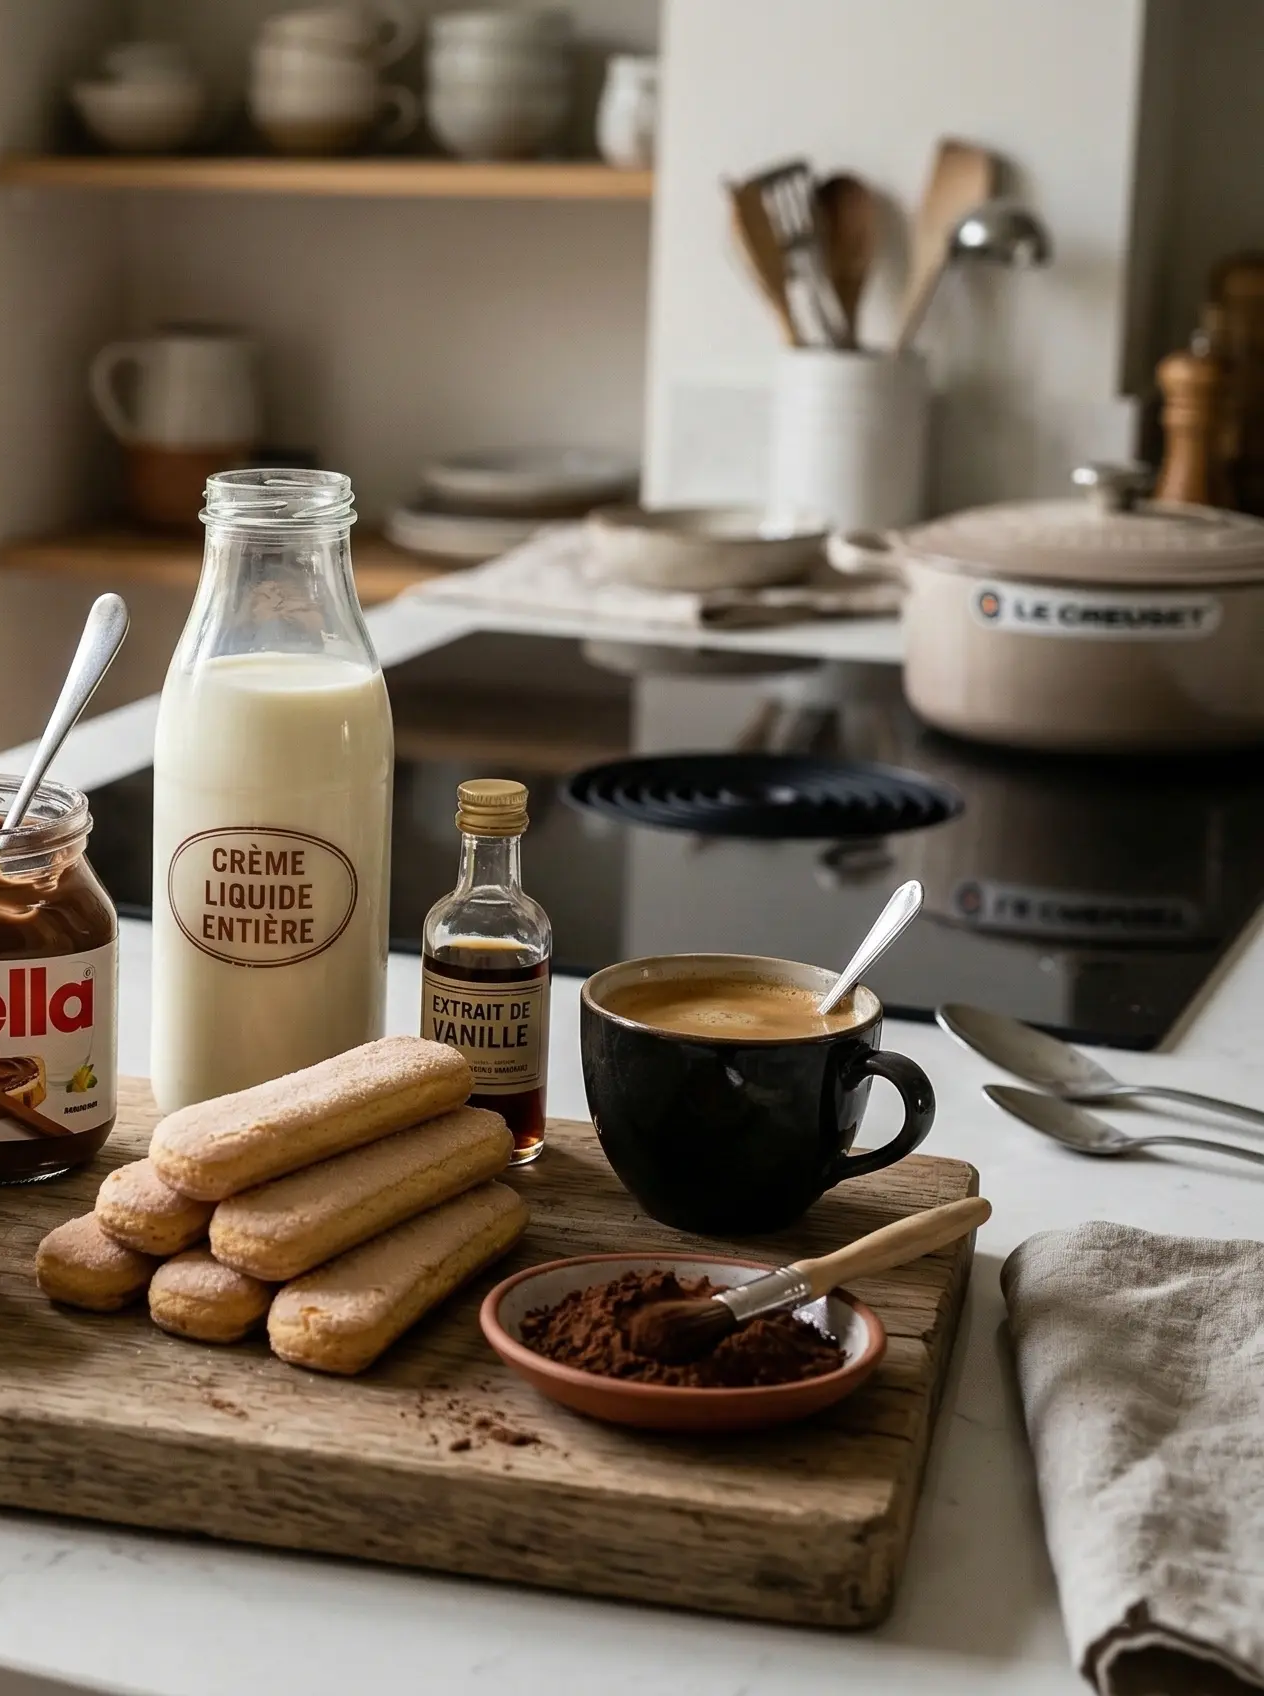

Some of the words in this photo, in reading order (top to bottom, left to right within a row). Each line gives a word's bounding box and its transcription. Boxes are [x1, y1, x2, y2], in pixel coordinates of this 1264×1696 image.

[1014, 599, 1050, 623] LE
[212, 843, 305, 876] CRÈME
[205, 880, 313, 910] LIQUIDE
[202, 913, 314, 945] ENTIÈRE
[432, 994, 504, 1022] EXTRAIT
[510, 1001, 531, 1021] DE
[432, 1016, 529, 1049] VANILLE
